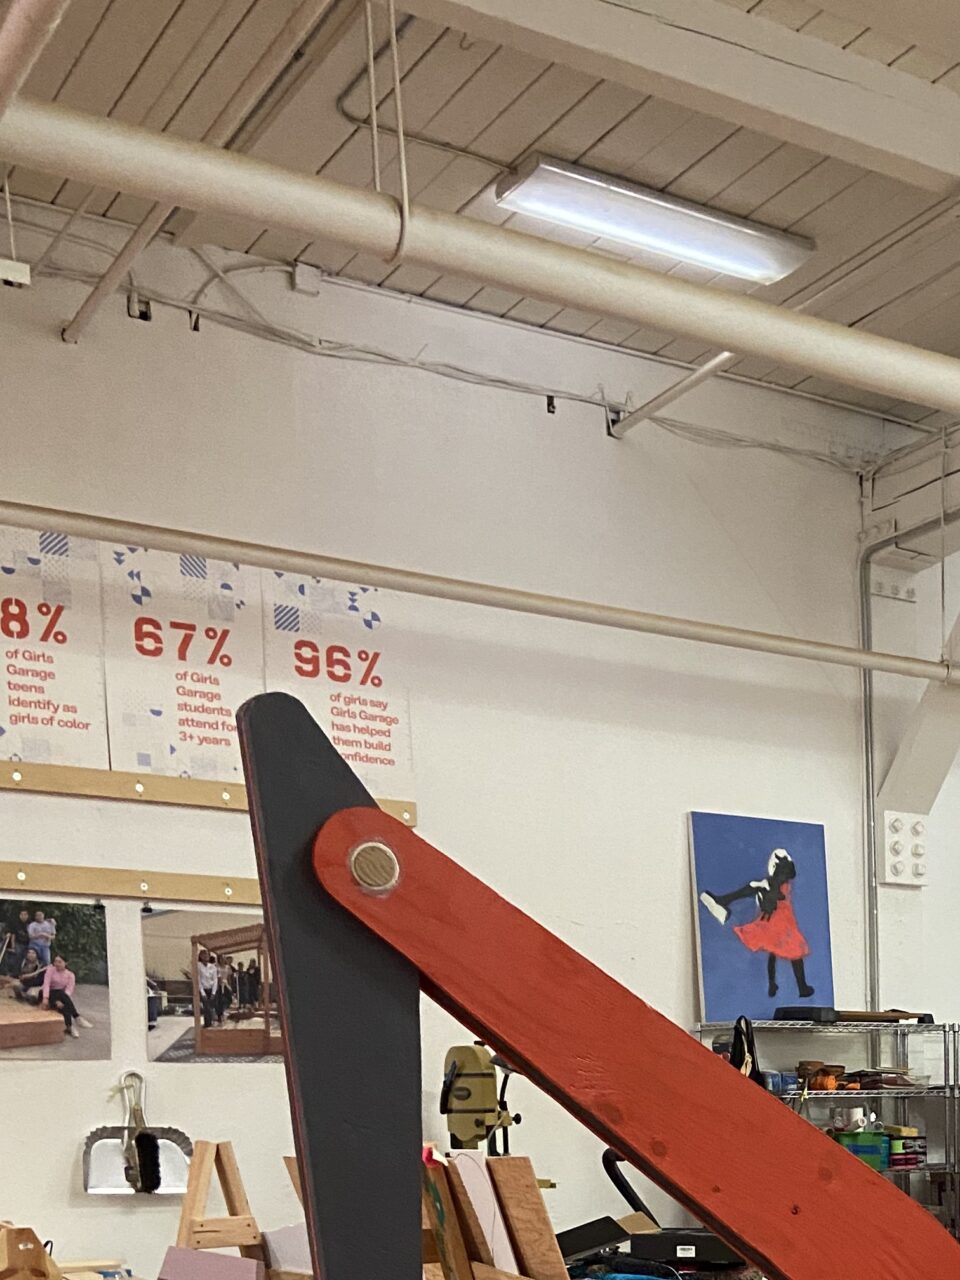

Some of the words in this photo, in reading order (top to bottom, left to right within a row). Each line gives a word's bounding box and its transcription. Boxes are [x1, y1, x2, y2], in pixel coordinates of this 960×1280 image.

[1, 597, 68, 645] 8%
[133, 614, 233, 668] 67%
[5, 649, 20, 660] of
[22, 650, 54, 664] Girls
[293, 639, 384, 689] 96%
[6, 664, 56, 681] Garage
[175, 671, 188, 681] of
[190, 672, 220, 685] Girls
[7, 681, 45, 695] teens
[176, 686, 222, 702] Garage
[8, 696, 60, 714] identify
[62, 704, 78, 713] as
[177, 702, 232, 717] students
[330, 693, 341, 702] of
[343, 696, 368, 706] girls
[369, 700, 388, 711] say
[9, 713, 39, 725] girls
[41, 716, 55, 727] of
[57, 719, 91, 730] color
[178, 718, 219, 730] attend
[330, 707, 357, 719] Girls
[359, 710, 399, 726] Garage
[331, 720, 352, 732] has
[353, 724, 391, 737] helped
[179, 731, 194, 742] 3+
[197, 735, 231, 746] years
[332, 736, 362, 748] them
[364, 740, 391, 751] build
[341, 752, 395, 766] onfidence
